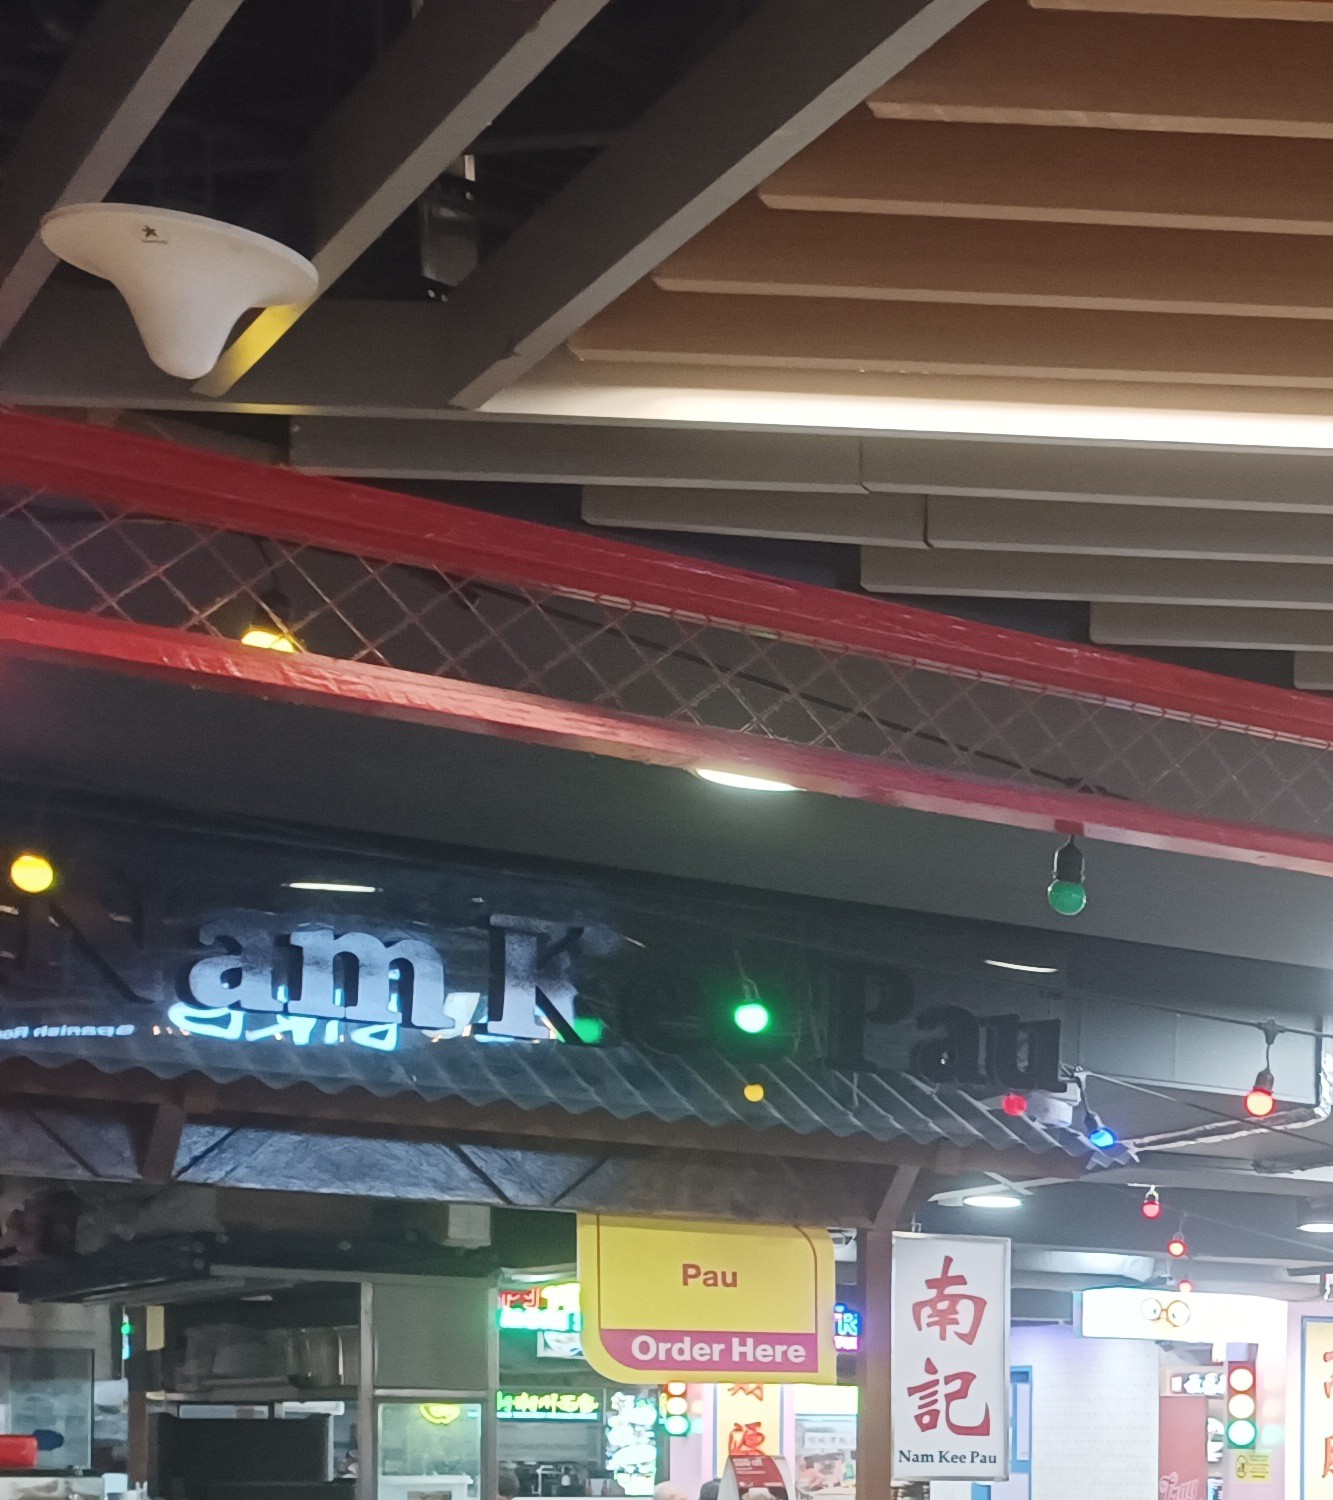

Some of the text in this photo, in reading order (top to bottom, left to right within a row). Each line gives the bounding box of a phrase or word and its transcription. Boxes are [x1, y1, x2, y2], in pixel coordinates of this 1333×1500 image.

[682, 1263, 738, 1288] Pau
[630, 1335, 806, 1364] Order Here
[906, 1254, 991, 1437] 南記
[898, 1449, 997, 1465] Nam Kee Pau
